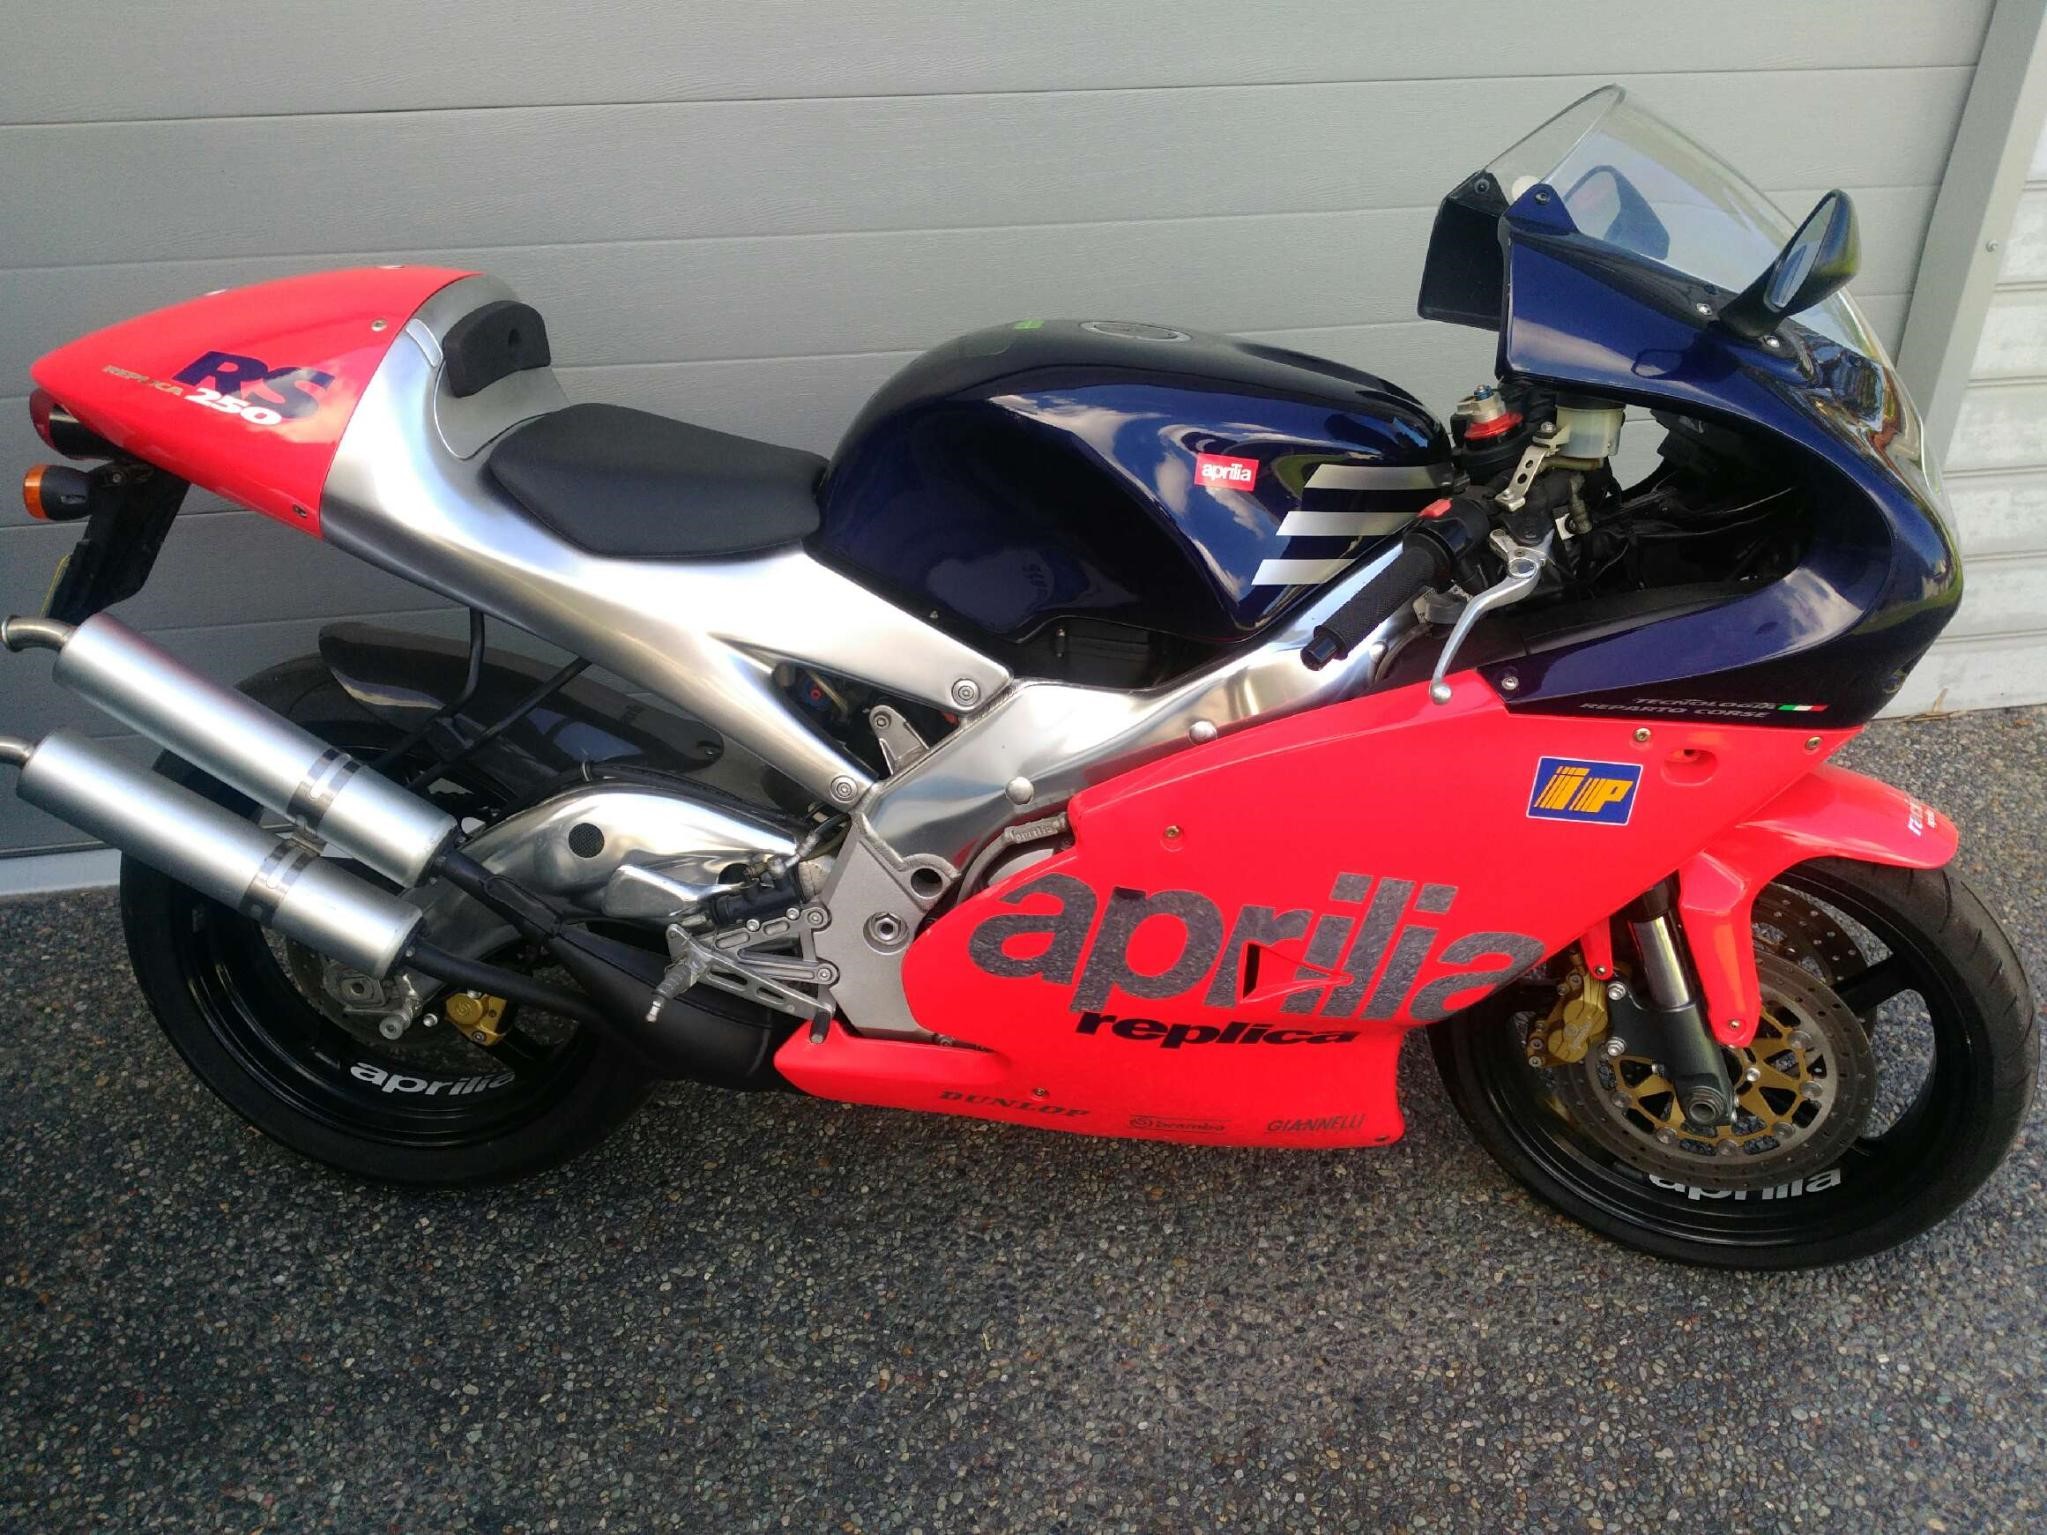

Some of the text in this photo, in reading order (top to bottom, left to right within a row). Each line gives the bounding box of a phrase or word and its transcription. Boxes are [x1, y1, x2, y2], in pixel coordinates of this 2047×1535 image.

[172, 350, 336, 420] RS
[184, 387, 283, 426] 250
[1201, 462, 1253, 483] aprilia
[1577, 702, 1770, 719] REPARTO CORSE
[967, 871, 1546, 1022] aprilia
[1075, 1011, 1362, 1050] replica
[350, 1061, 516, 1096] aprilia
[939, 1090, 1091, 1117] DUNLOP
[1154, 1118, 1227, 1133] brembo
[1265, 1112, 1367, 1133] GIANNELLI
